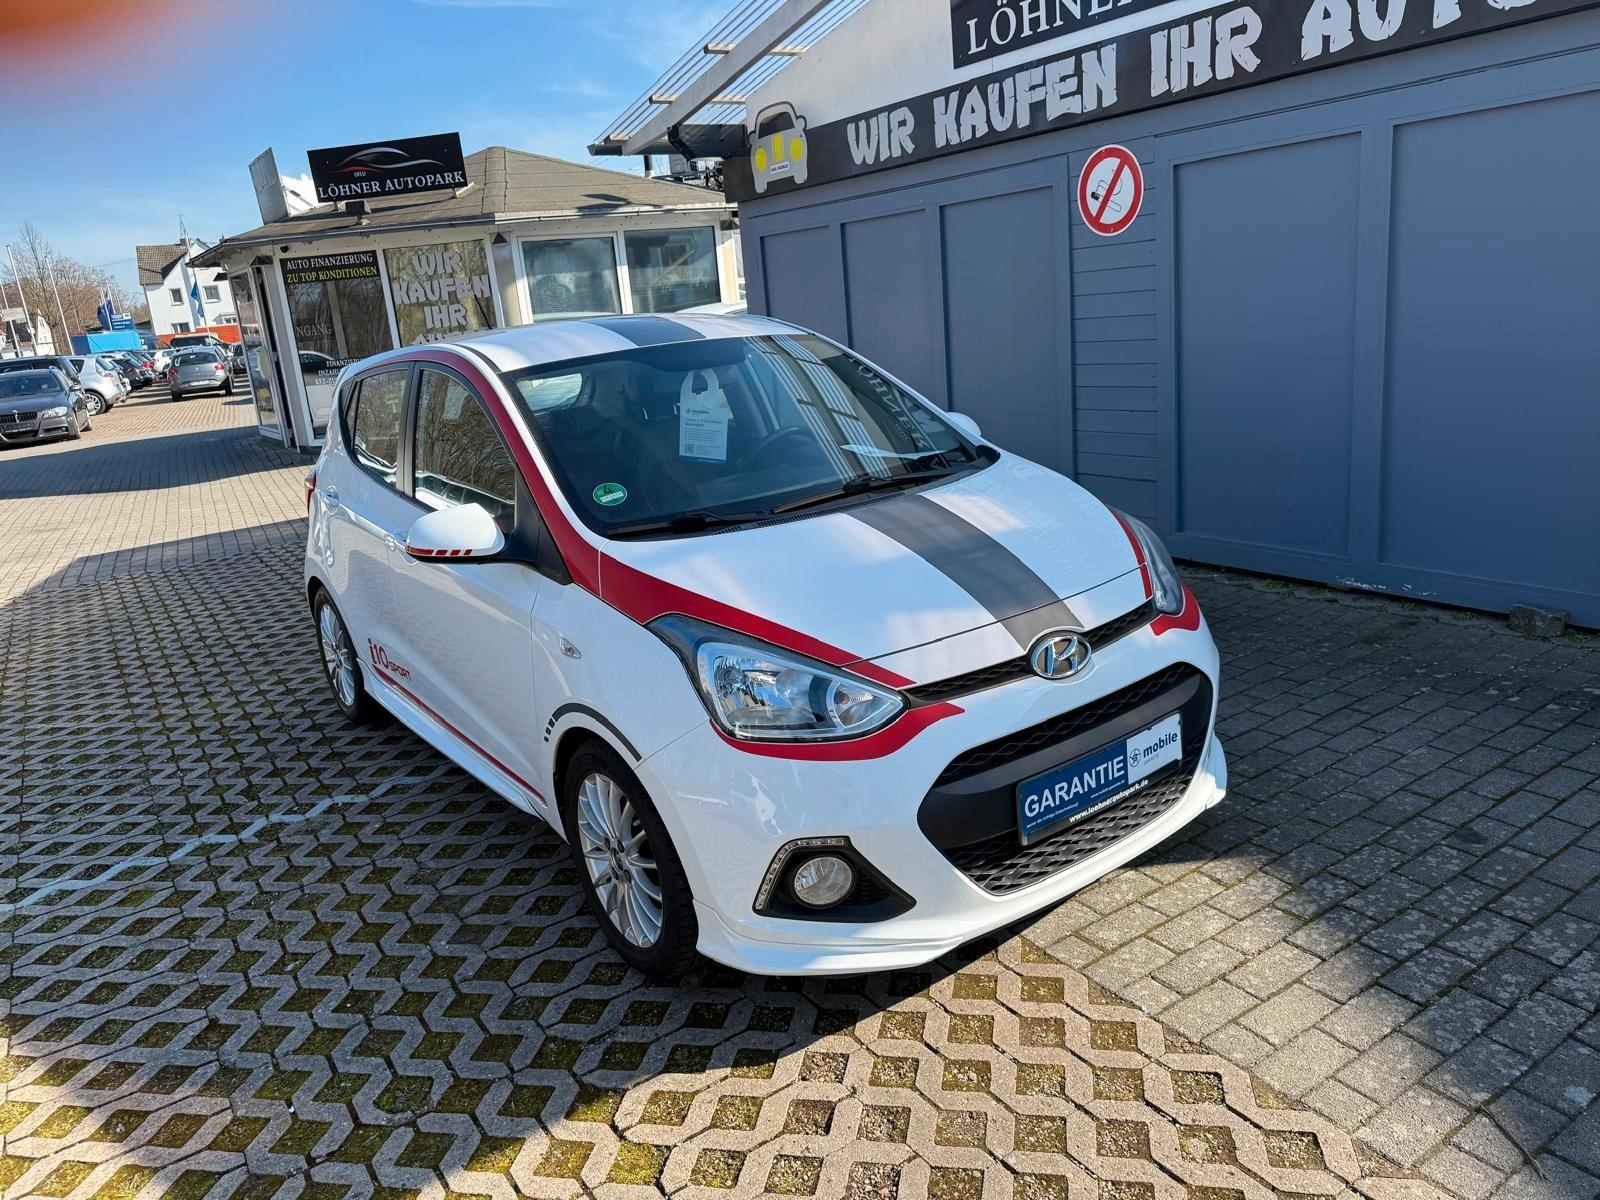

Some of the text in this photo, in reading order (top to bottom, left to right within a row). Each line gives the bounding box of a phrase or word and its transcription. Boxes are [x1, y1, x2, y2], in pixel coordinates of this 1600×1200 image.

[966, 0, 1132, 55] LÖHN
[846, 0, 1537, 166] WIR KAUFEN IHR AU
[318, 171, 465, 198] LÖHNER AUTOPARK
[287, 253, 373, 270] AUTO FINANZIERUNG
[287, 266, 378, 283] ZU TOP KONDITIONEN
[411, 251, 463, 276] WIR
[392, 274, 491, 305] KAUFEN
[423, 303, 468, 329] IHR
[295, 323, 332, 338] NGANG
[1143, 732, 1178, 758] mobile
[1024, 755, 1125, 818] GARANTIE
[1069, 778, 1149, 823] www.loehnerautopark.de
